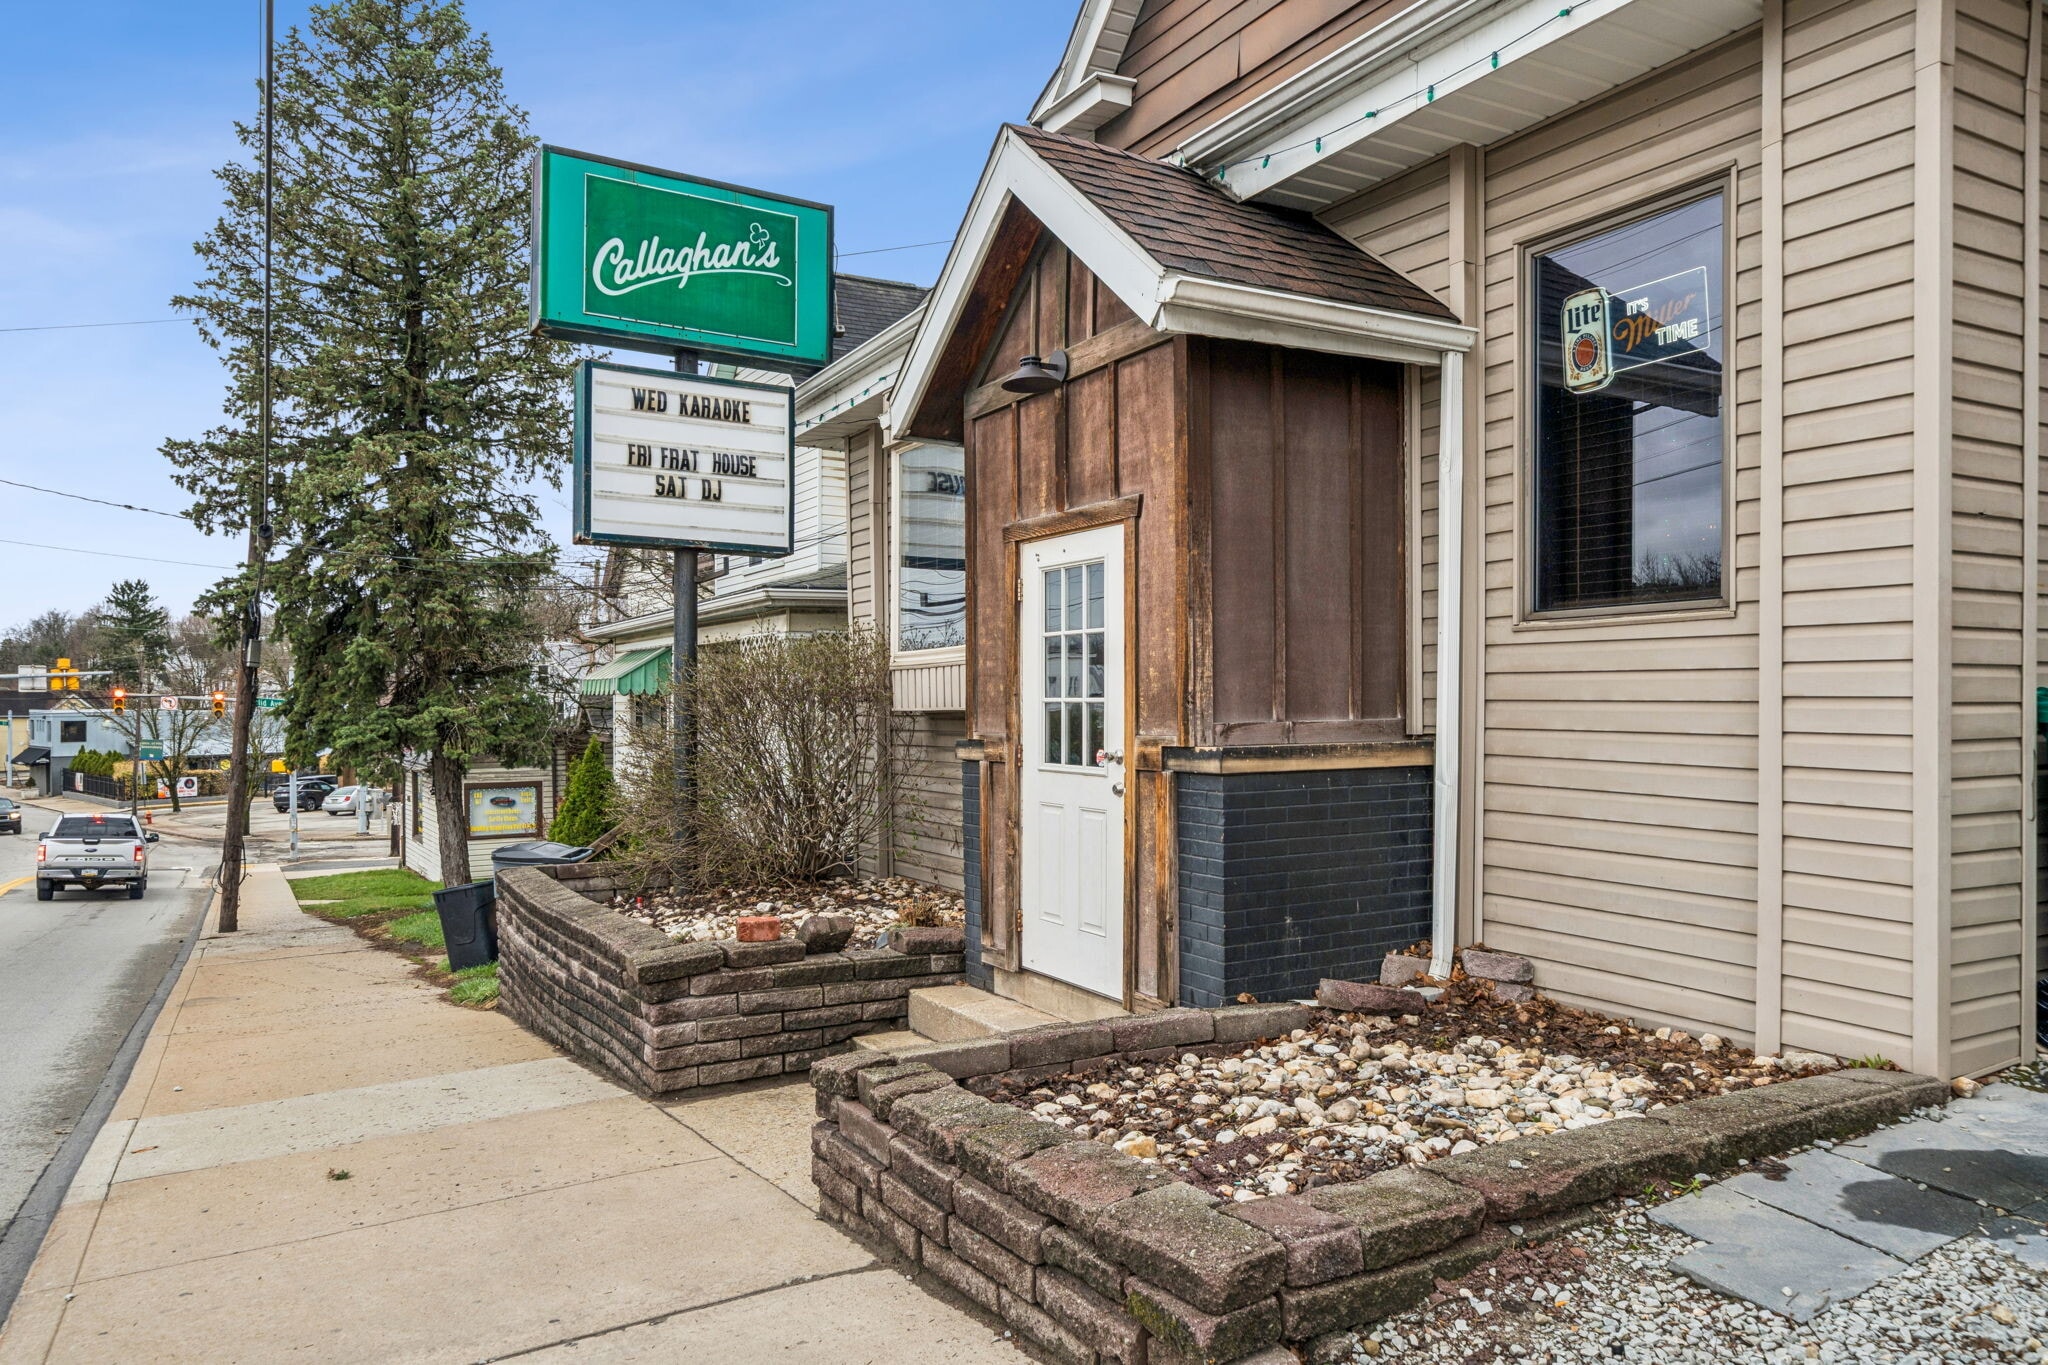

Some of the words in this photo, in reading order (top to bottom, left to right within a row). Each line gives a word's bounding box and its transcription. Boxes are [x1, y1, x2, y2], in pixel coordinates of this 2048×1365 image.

[592, 229, 783, 296] Callaghan's
[1567, 304, 1600, 334] Lite
[1613, 292, 1696, 352] Miller
[1626, 297, 1649, 316] IT'S
[1655, 318, 1698, 346] TIME
[631, 387, 667, 413] WED
[679, 393, 750, 423] KARAOKE
[628, 443, 652, 466] FRI
[660, 447, 699, 471] FRAT
[712, 452, 757, 478] HOUSE
[655, 474, 687, 498] SAT
[701, 478, 722, 500] DJ
